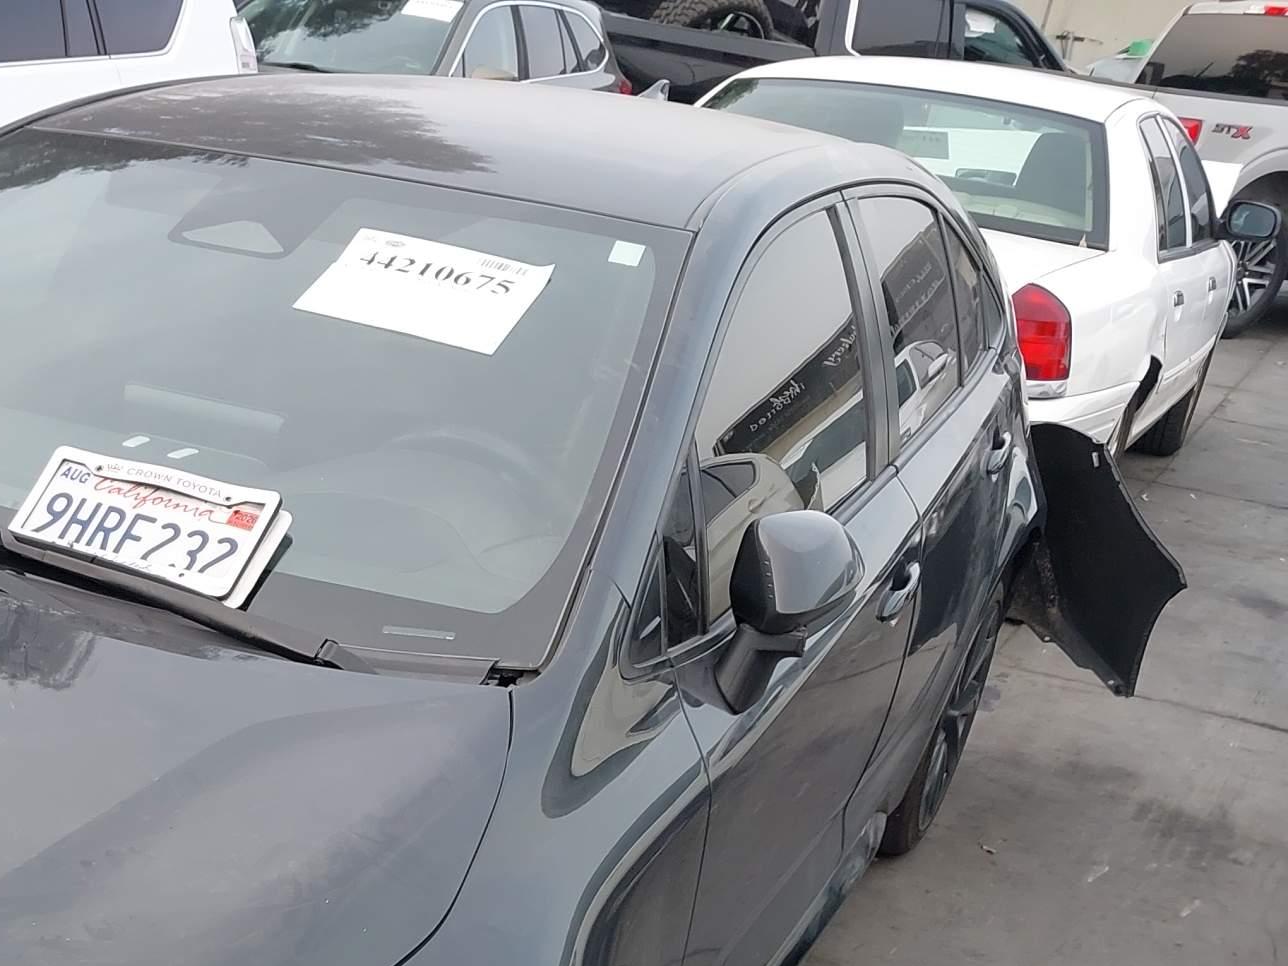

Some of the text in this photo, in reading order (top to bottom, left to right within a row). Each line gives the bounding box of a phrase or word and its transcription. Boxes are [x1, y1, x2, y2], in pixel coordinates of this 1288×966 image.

[1212, 123, 1253, 140] STX
[360, 251, 516, 294] 44210675
[61, 466, 91, 485] AUG
[126, 466, 222, 499] CROWN TOYOTA
[94, 476, 224, 523] California
[32, 492, 239, 574] 9HRF232
